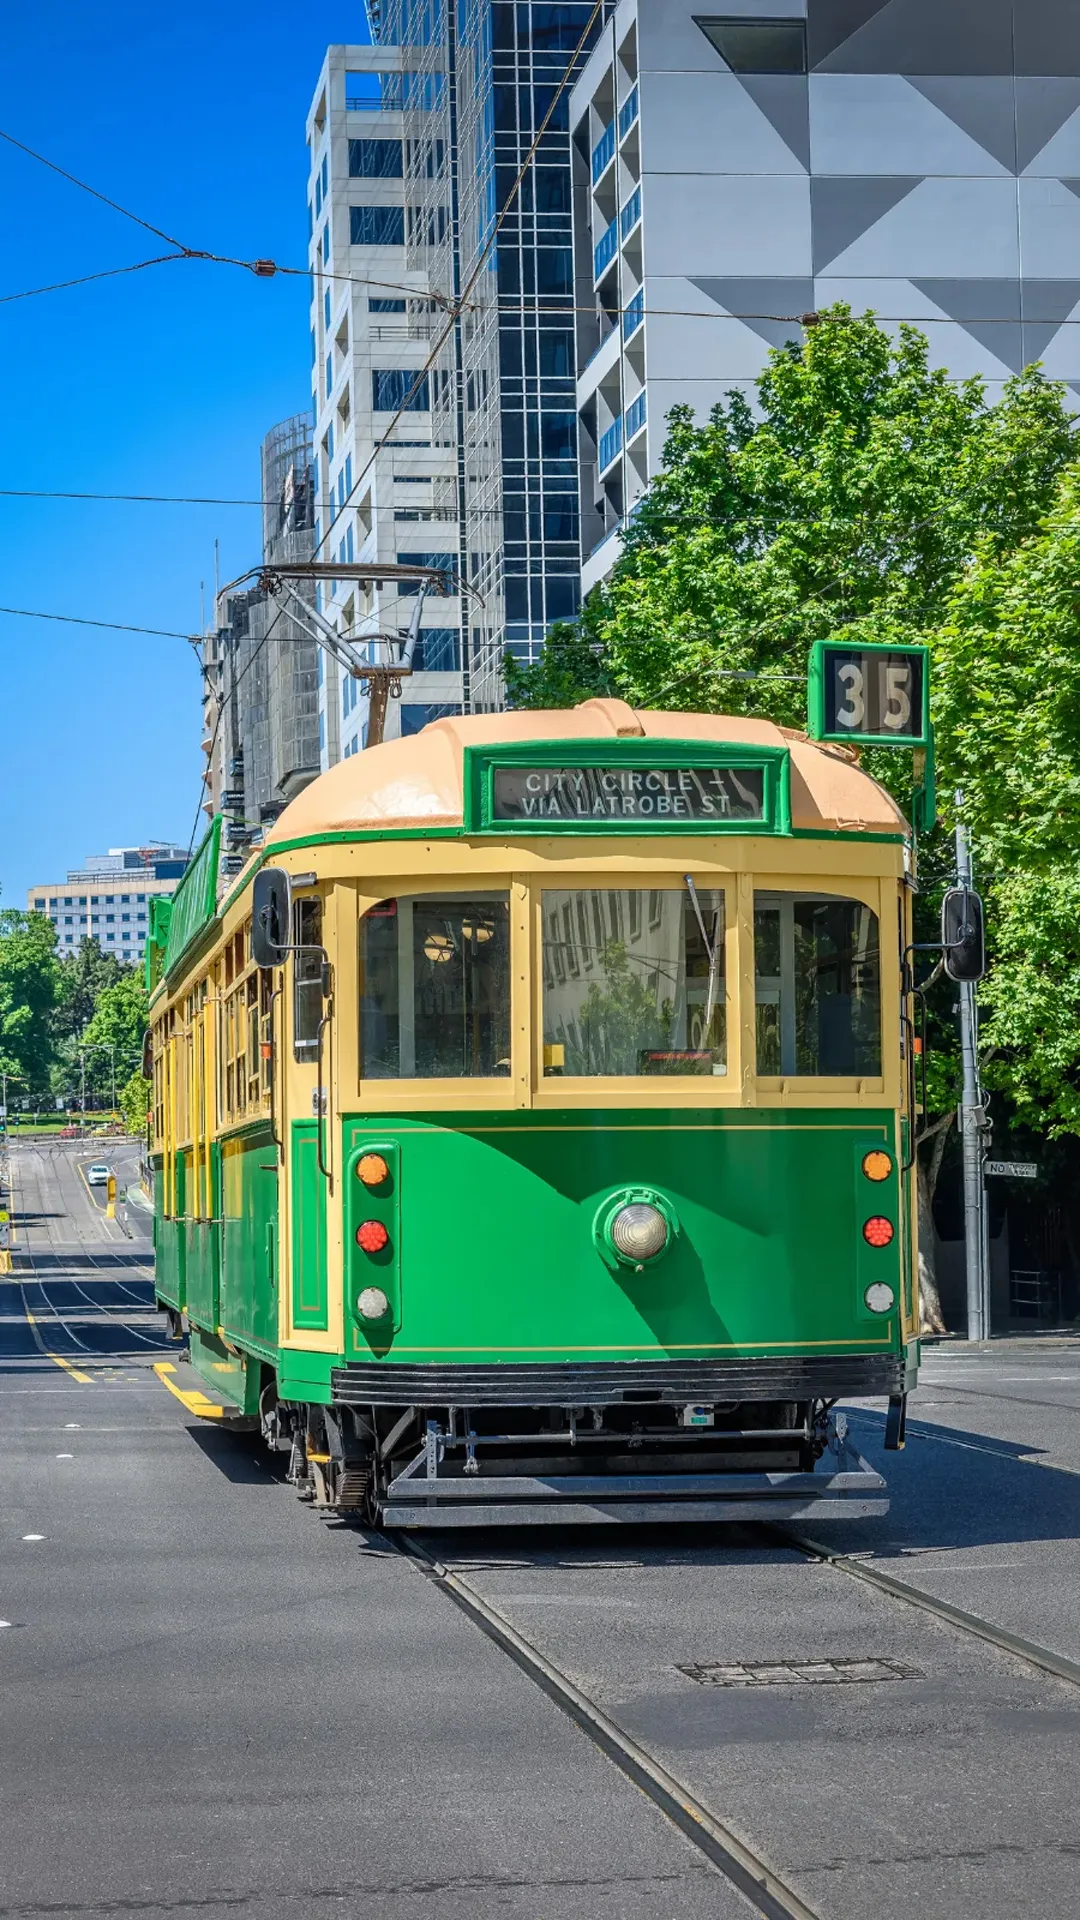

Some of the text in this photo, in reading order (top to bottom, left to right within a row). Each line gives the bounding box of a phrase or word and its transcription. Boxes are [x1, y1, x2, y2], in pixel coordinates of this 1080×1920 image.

[837, 664, 911, 729] 35
[526, 773, 583, 792] CITY
[602, 772, 693, 791] CIRCLE
[522, 794, 730, 816] VIA LATROBE ST
[990, 1164, 1005, 1173] NO
